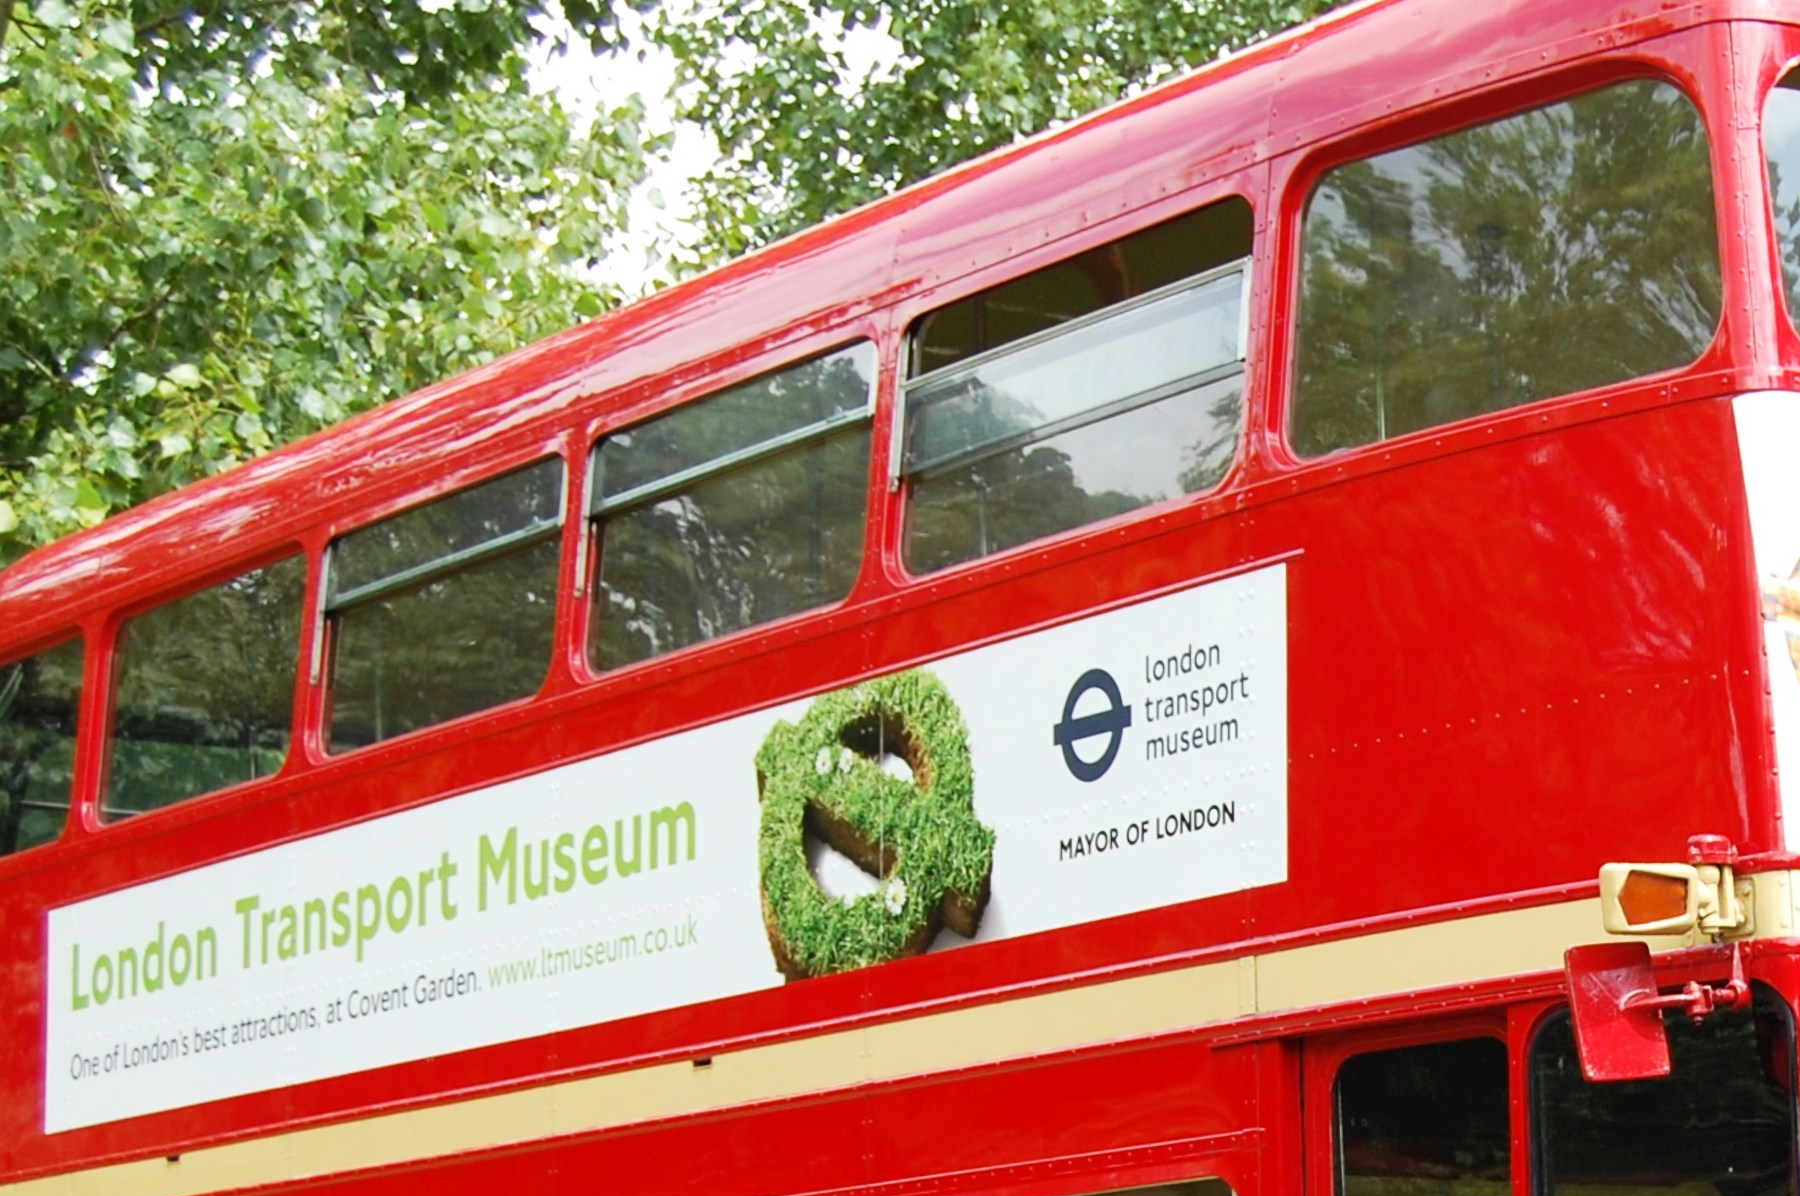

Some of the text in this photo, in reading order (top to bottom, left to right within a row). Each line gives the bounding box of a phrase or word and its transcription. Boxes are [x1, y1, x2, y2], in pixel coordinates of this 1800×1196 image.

[1145, 643, 1220, 684] london
[1145, 672, 1249, 723] transport
[1146, 717, 1239, 761] museum
[1059, 801, 1236, 862] MAYOR OF LONDON
[70, 800, 697, 1011] London Transport Museum
[70, 1053, 99, 1080] One
[104, 1045, 120, 1073] of
[194, 1025, 227, 1054] best
[231, 1005, 322, 1047] attractions,
[326, 1000, 344, 1026] at
[347, 985, 409, 1020] Covent
[413, 967, 483, 1006] Garden.
[488, 913, 699, 990] www.ltmuseum.co.uk
